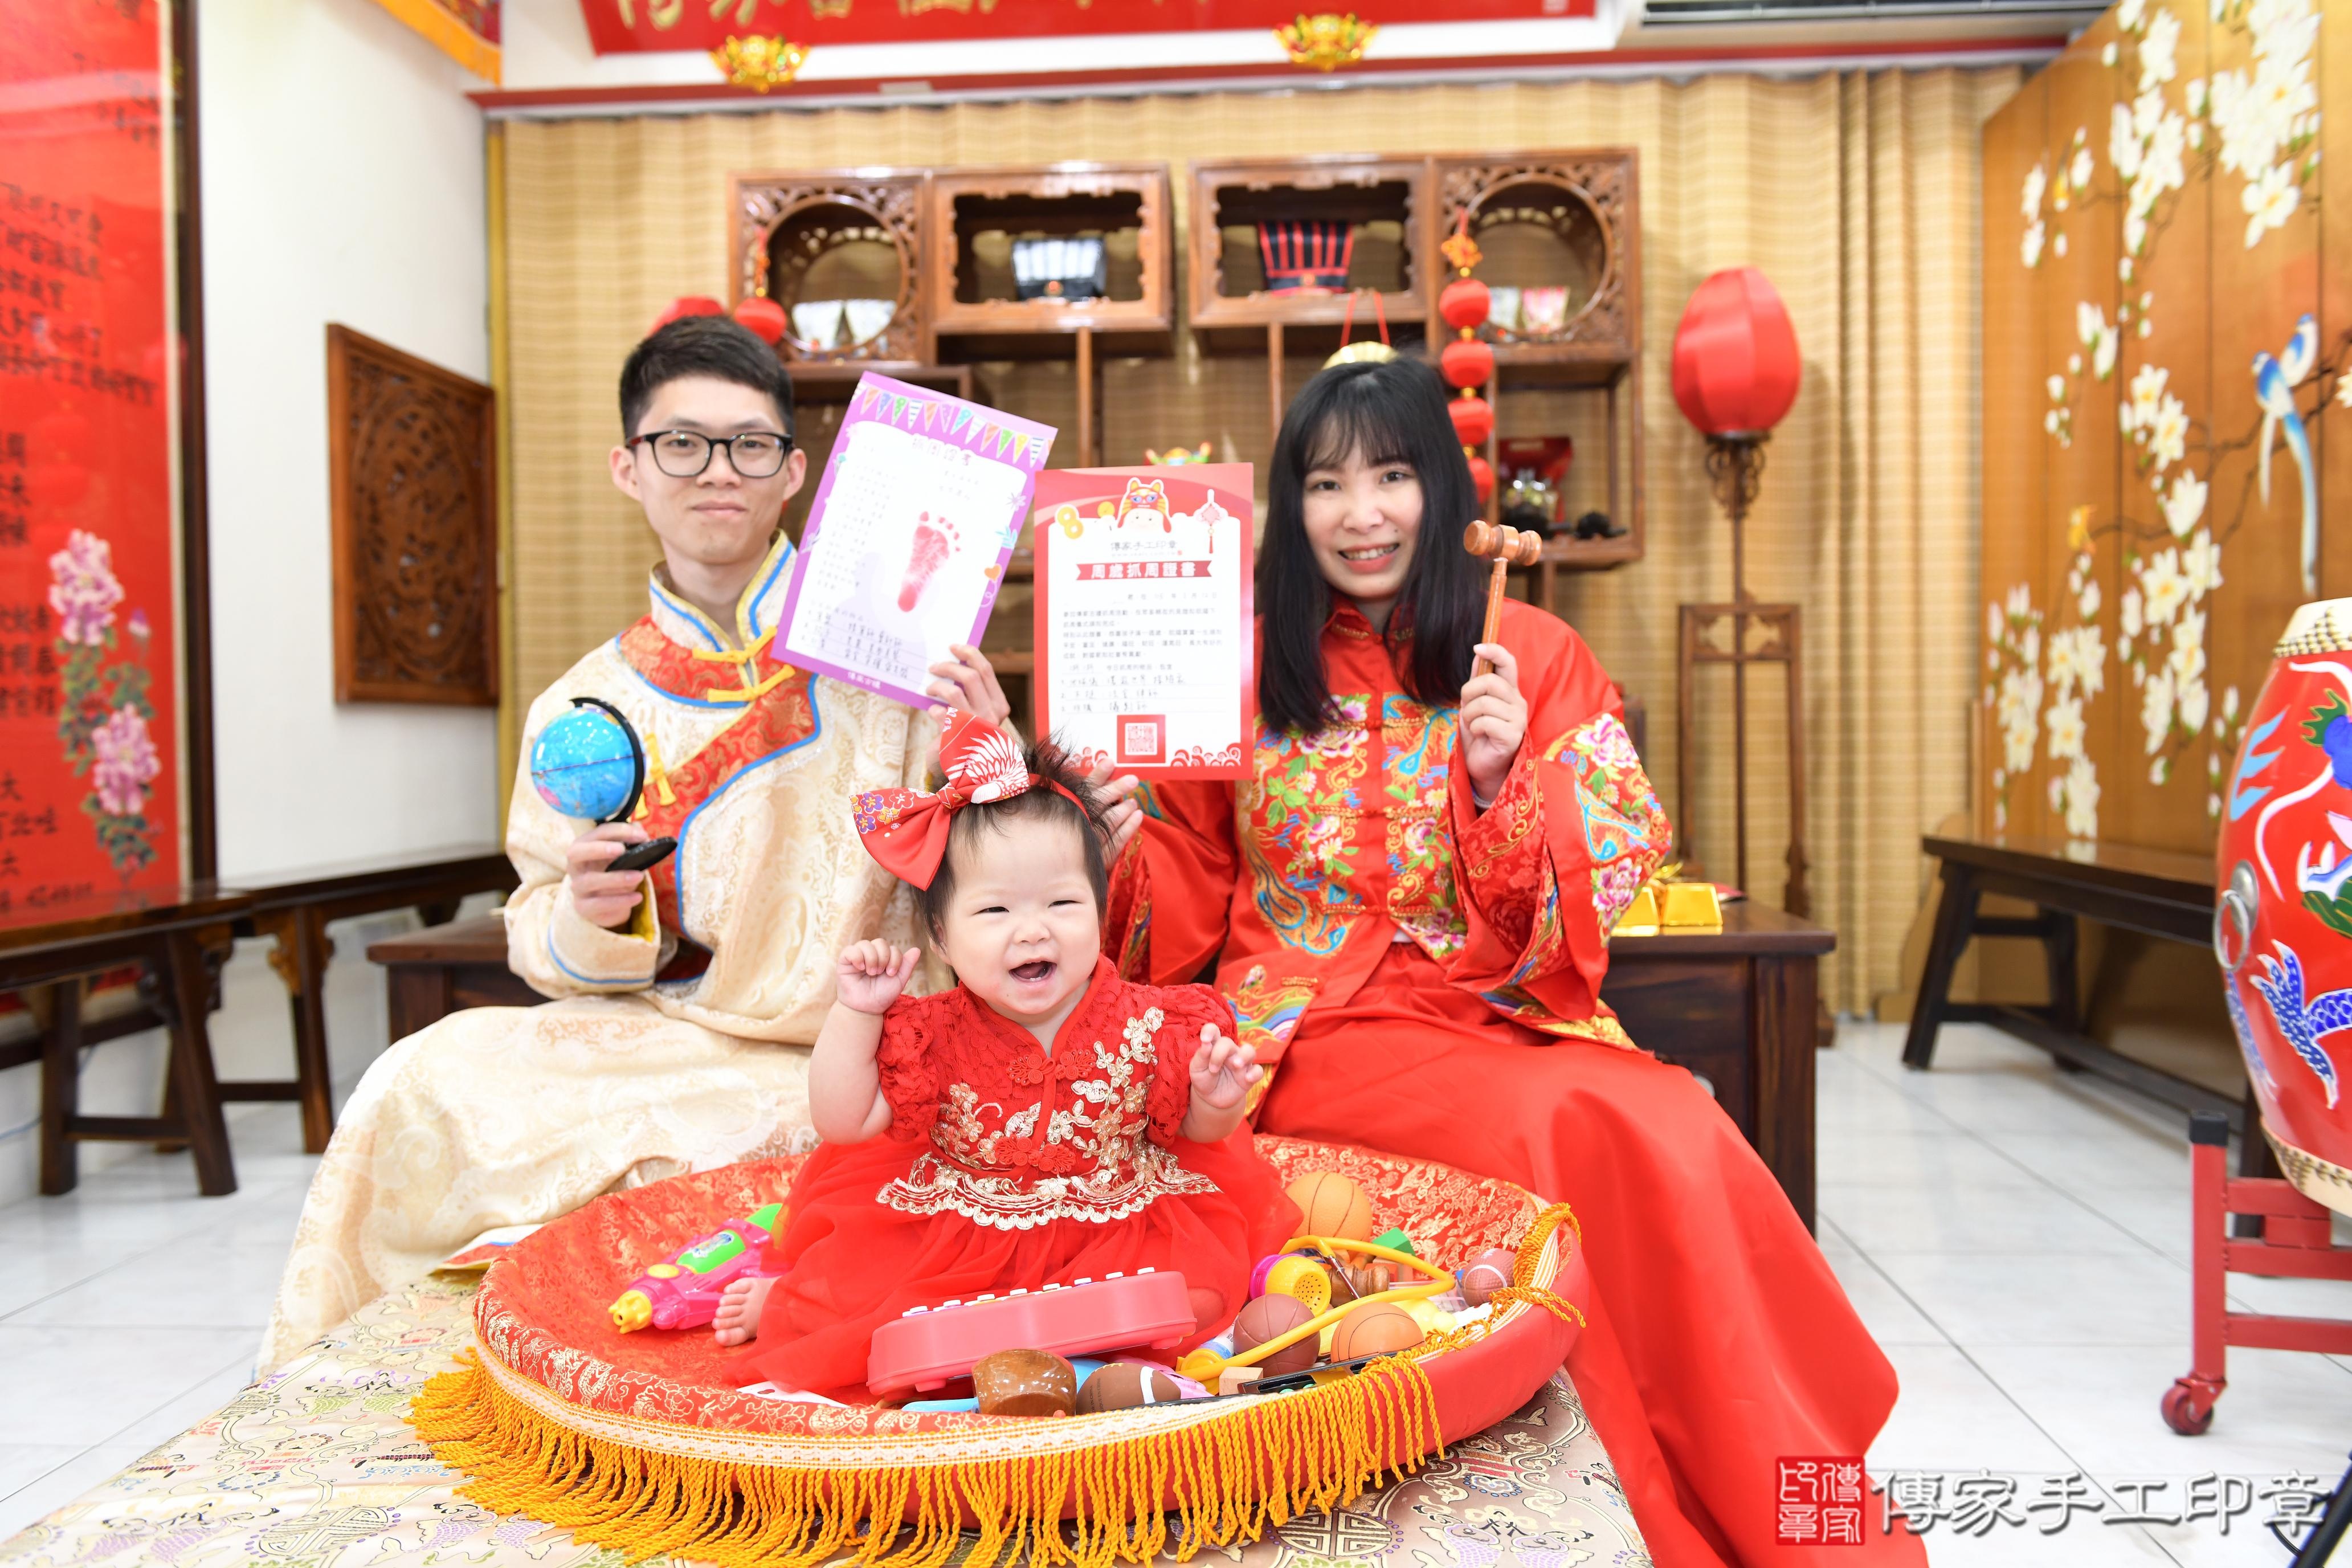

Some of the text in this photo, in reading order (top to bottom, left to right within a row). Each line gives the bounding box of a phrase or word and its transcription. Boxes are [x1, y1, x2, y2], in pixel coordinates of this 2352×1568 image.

[1091, 562, 1197, 579] 周歲抓周證書
